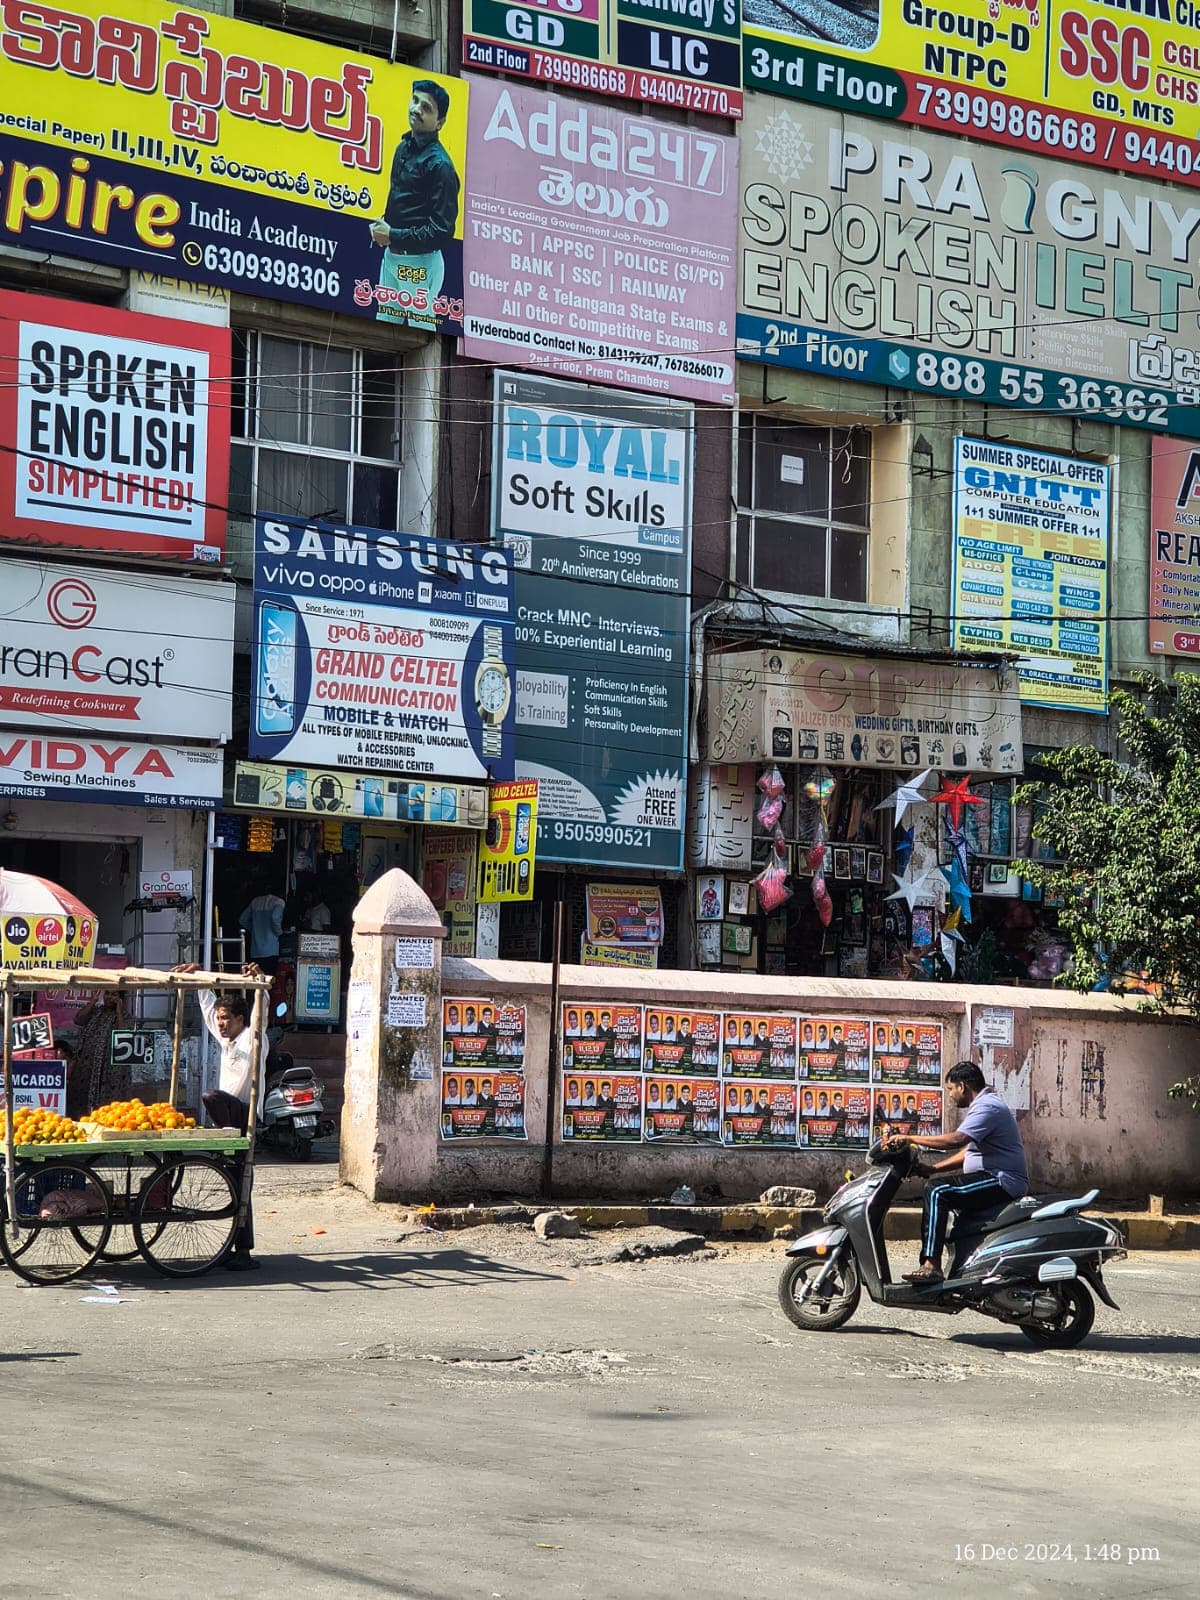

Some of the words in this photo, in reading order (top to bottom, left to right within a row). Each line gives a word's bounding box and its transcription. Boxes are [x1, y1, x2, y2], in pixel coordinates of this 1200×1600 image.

[505, 9, 565, 47] GD
[902, 0, 1031, 52] Group-D
[650, 31, 709, 76] LIC
[924, 42, 1008, 88] NTPC
[1060, 11, 1150, 92] SSC
[469, 42, 494, 64] 2nd
[496, 48, 528, 71] Floor
[535, 54, 626, 94] 7399986668
[640, 76, 728, 113] 9440472770
[750, 47, 805, 87] 3rd
[816, 62, 899, 108] Floor
[913, 82, 1097, 154] 7399986668
[1092, 90, 1126, 117] GD,
[1132, 99, 1174, 126] MTS
[0, 157, 181, 249] pire
[538, 164, 670, 228] తెలుగు
[188, 201, 242, 237] India
[248, 215, 339, 262] Academy
[471, 199, 505, 216] India's
[507, 206, 547, 227] Leading
[550, 216, 610, 239] Government
[612, 230, 631, 243] Job
[633, 234, 689, 255] Preparation
[690, 246, 730, 263] Platform
[742, 182, 1017, 293] SPOKEN
[471, 219, 523, 246] TSPSC
[542, 235, 595, 260] APPSC
[614, 250, 668, 276] POLICE
[673, 262, 725, 290] (SI/PC)
[204, 244, 340, 297] 6309398306
[510, 253, 553, 278] BANK
[572, 266, 602, 287] SSC
[621, 276, 687, 304] RAILWAY
[742, 247, 1017, 358] ENGLISH
[1035, 241, 1200, 334] IELT
[764, 323, 798, 356] 2nd
[806, 331, 869, 372] Floor
[30, 340, 196, 417] SPOKEN
[916, 352, 987, 396] 888
[999, 366, 1045, 404] 55
[1057, 376, 1169, 427] 36362
[30, 399, 195, 475] ENGLISH
[506, 406, 680, 486] ROYAL
[962, 444, 1013, 467] SUMMER
[1016, 453, 1065, 477] SPECIAL
[1067, 463, 1104, 484] OFFER
[28, 459, 194, 513] SIMPLIFIED!
[509, 473, 575, 514] Soft
[585, 486, 666, 527] Skills
[964, 466, 1101, 508] GNITT
[966, 487, 1031, 506] COMPUTER
[1034, 498, 1100, 518] EDUCATION
[642, 527, 681, 546] Campus
[964, 504, 984, 519] 1+1
[988, 508, 1039, 529] SUMMER
[1041, 518, 1078, 535] OFFER
[1082, 524, 1101, 539] 1+1
[263, 520, 508, 586] SAMSUNG
[959, 538, 976, 549] NO
[976, 541, 995, 551] AGE
[996, 543, 1021, 555] LIMIT
[963, 518, 1101, 558] FREE
[579, 544, 610, 562] Since
[613, 549, 642, 566] 1999
[963, 559, 1003, 573] ADCA
[1049, 553, 1070, 566] JOIN
[1071, 556, 1103, 569] TODAY
[263, 562, 315, 588] vivo
[319, 574, 366, 595] oppo
[378, 581, 415, 600] iPhone
[434, 588, 462, 602] xiaomi
[541, 557, 560, 572] 20th
[561, 562, 619, 584] Anniversary
[620, 568, 679, 589] Celebrations
[1015, 568, 1052, 581] C-Lang.
[1017, 578, 1050, 591] C++
[1064, 597, 1095, 610] PHOTOSHOP
[1065, 587, 1096, 600] WINGS
[518, 606, 554, 624] Crack
[557, 608, 592, 628] MNC
[599, 616, 663, 638] Interviews.
[963, 626, 1001, 640] TYPING
[544, 631, 617, 652] Experiential
[620, 639, 673, 662] Learning
[1013, 634, 1028, 643] WEB
[315, 648, 385, 681] GRAND
[390, 655, 458, 688] CELTEL
[1028, 670, 1055, 681] ORACLE,
[1072, 676, 1098, 687] PYTHON
[11, 691, 70, 710] Redefining
[73, 697, 126, 712] Cookware
[315, 679, 457, 712] COMMUNICATION
[585, 690, 647, 705] Communication
[648, 696, 668, 709] Skills
[323, 705, 378, 727] MOBILE
[383, 711, 395, 728] &
[399, 712, 449, 733] WATCH
[584, 717, 629, 733] Personality
[630, 721, 682, 738] Development
[854, 714, 890, 731] WEDDING
[892, 717, 916, 735] GIFTS,
[917, 719, 954, 735] BIRTHDAY
[955, 721, 980, 737] GIFTS.
[301, 722, 316, 734] ALL
[317, 723, 342, 737] TYPES
[343, 726, 353, 738] OF
[354, 727, 383, 742] MOBILE
[384, 730, 425, 747] REPAIRING,
[426, 735, 469, 749] UNLOCKING
[0, 739, 175, 778] VIDYA
[337, 753, 363, 767] WATCH
[365, 755, 404, 770] REPAIRING
[406, 759, 435, 773] CENTER
[23, 770, 71, 787] Sewing
[75, 773, 137, 789] Machines
[645, 785, 676, 800] Attend
[637, 814, 654, 825] ONE
[655, 815, 677, 827] WEEK
[644, 799, 676, 816] FREE
[554, 822, 652, 848] 9505990521
[142, 882, 188, 892] GranCast
[7, 923, 28, 937] Jio
[38, 932, 59, 942] airtel
[4, 960, 63, 970] AVAILABLE
[20, 945, 47, 958] SIM
[68, 945, 84, 958] SIM
[12, 1020, 32, 1050] 10
[114, 1033, 146, 1062] 50
[0, 1074, 62, 1087] SMCARDS
[38, 1093, 59, 1108] VI
